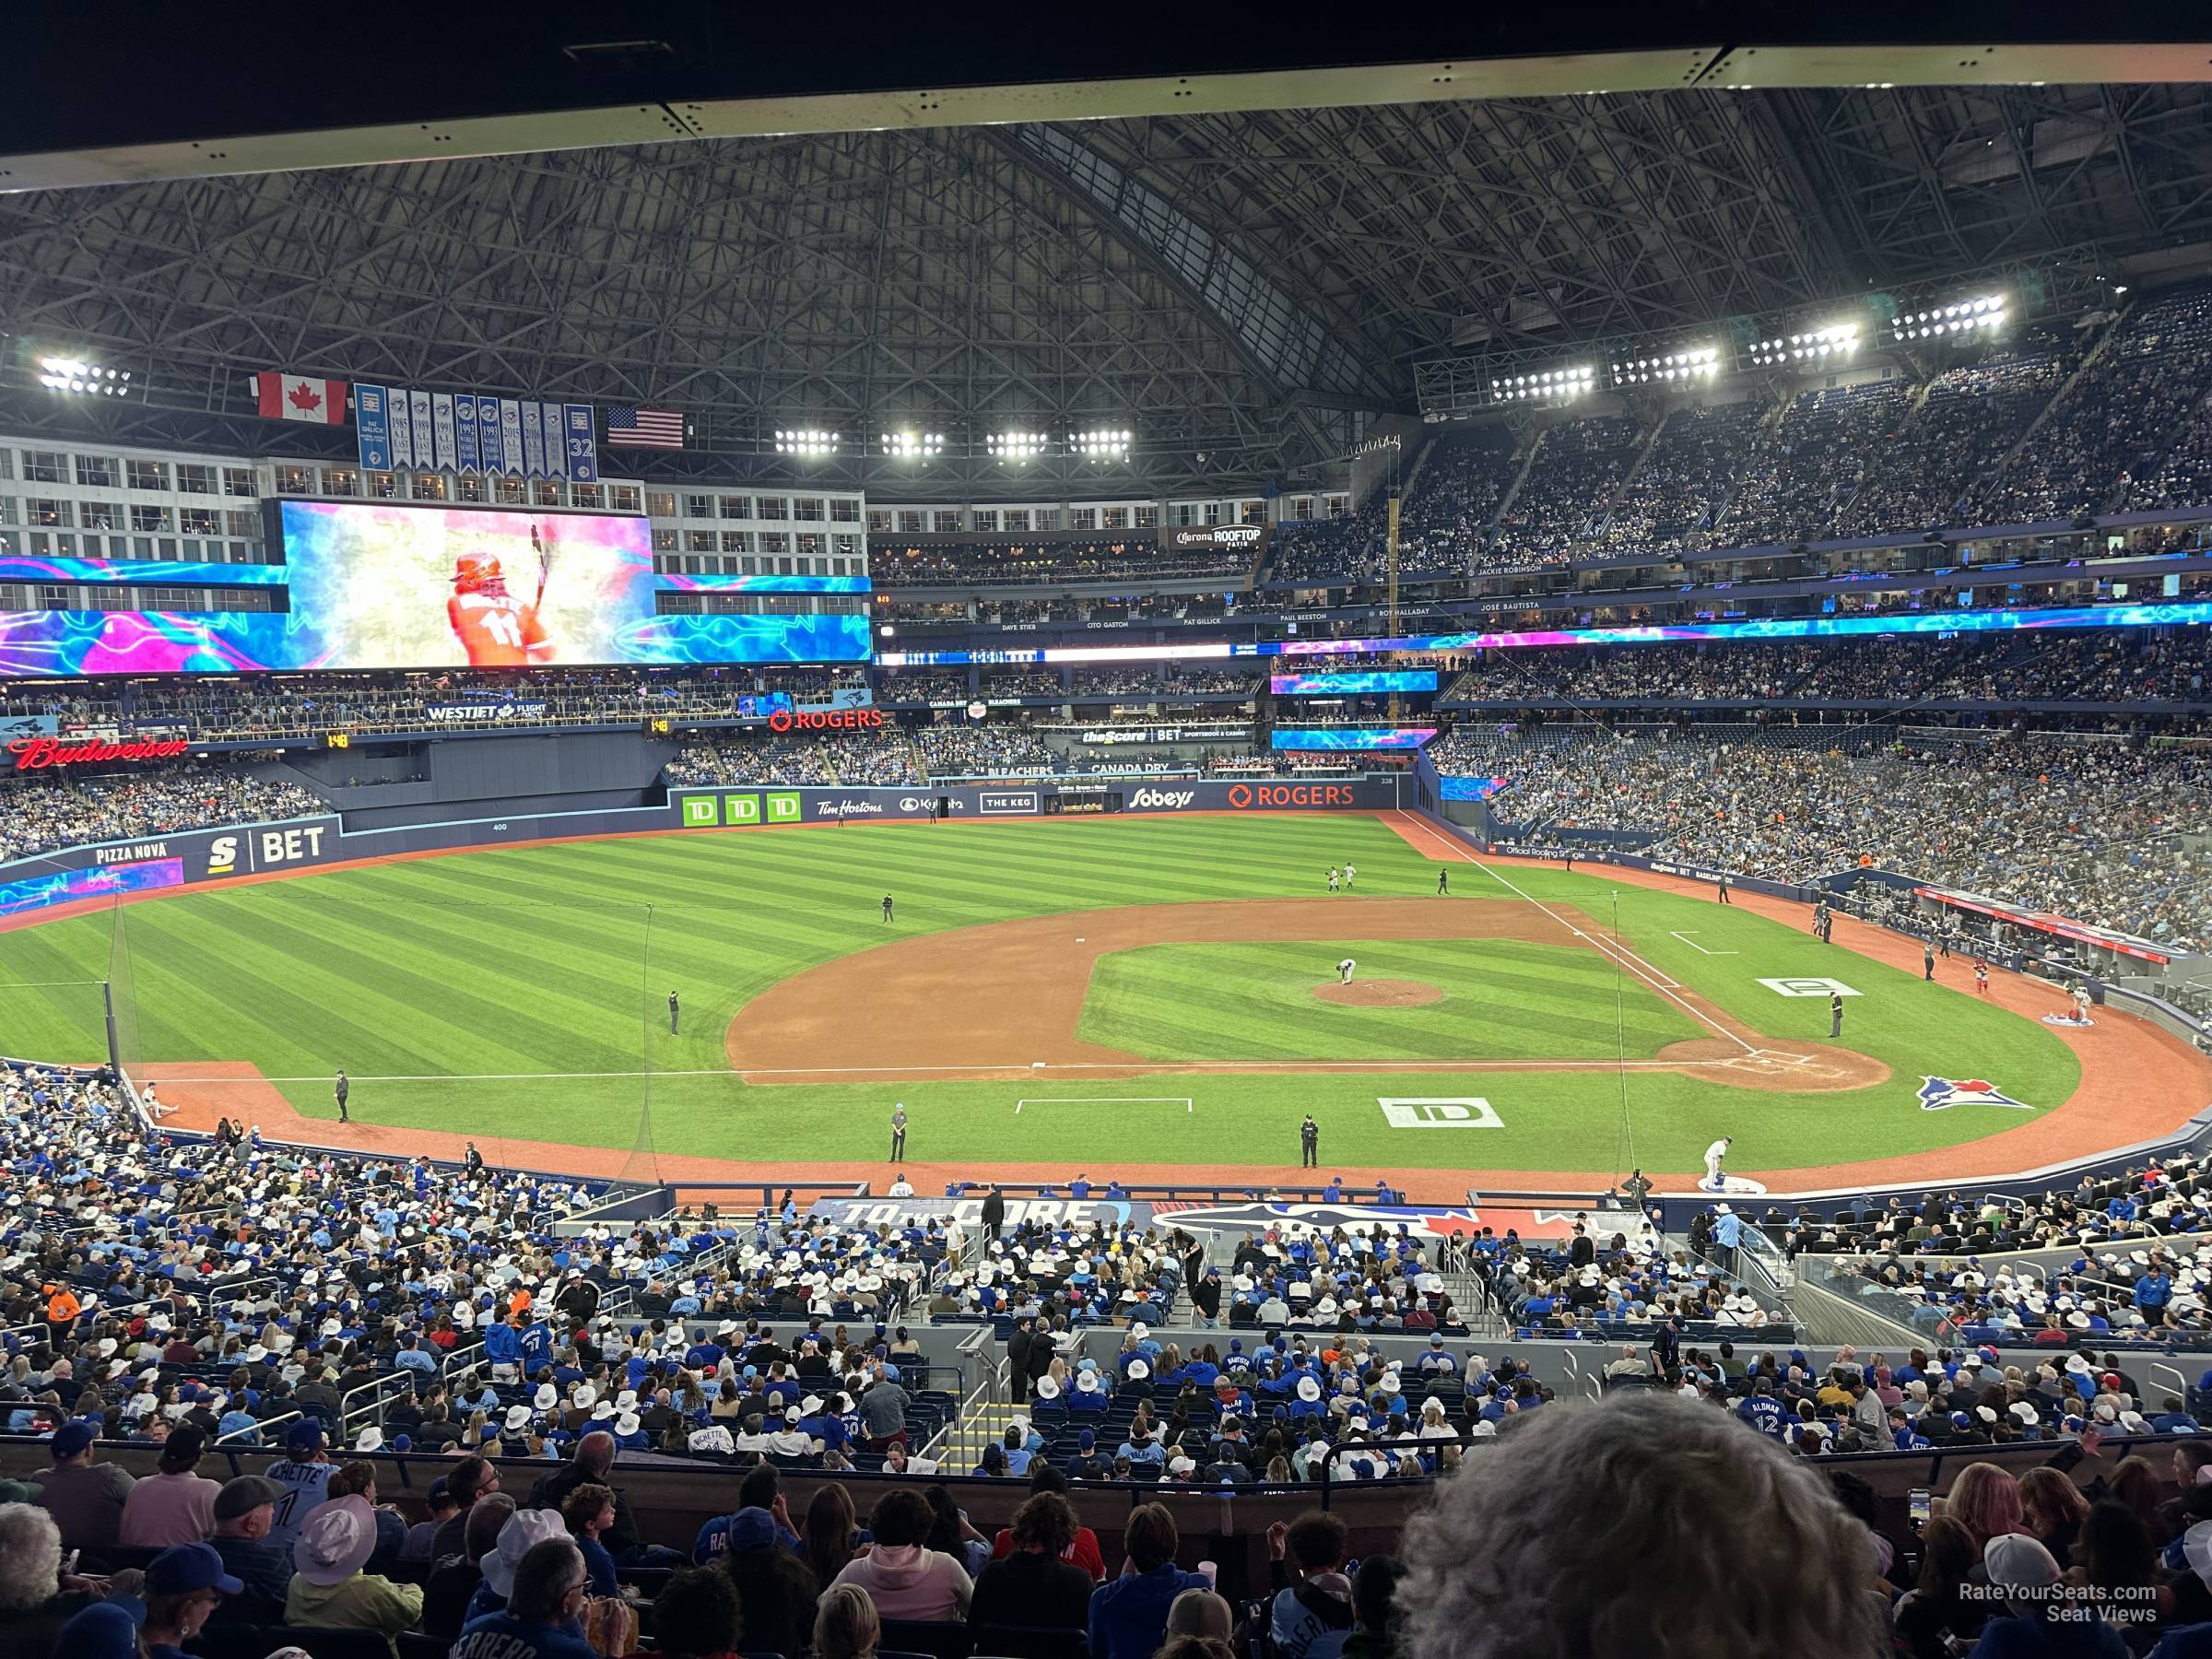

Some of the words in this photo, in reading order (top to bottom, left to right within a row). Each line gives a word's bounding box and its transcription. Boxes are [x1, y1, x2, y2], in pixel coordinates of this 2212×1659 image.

[392, 417, 408, 429] 1985
[414, 419, 430, 432] 1989
[436, 421, 453, 434] 1991
[459, 423, 476, 436] 1992
[483, 425, 500, 438] 1993
[503, 427, 520, 440] 2015
[525, 429, 542, 441] 2016
[394, 439, 409, 449] EAST
[415, 441, 430, 452] EAST
[438, 443, 454, 453] EAST
[569, 438, 594, 457] 32
[1176, 532, 1213, 546] Corona
[1214, 529, 1261, 543] ROOFTOP
[1478, 568, 1502, 576] JACKIE
[1503, 565, 1542, 575] ROBINSON
[1394, 607, 1430, 616] HALLADAY
[1503, 602, 1539, 610] BAUTISTA
[1280, 614, 1296, 622] PAUL
[1297, 613, 1327, 621] BEESTON
[1019, 623, 1036, 631] STIEB
[428, 706, 498, 721] WESTJET
[516, 703, 546, 712] FLIGHT
[797, 710, 884, 729] ROGERS
[1082, 731, 1147, 743] theScore
[1158, 730, 1181, 740] BET
[7, 735, 188, 771] Budweiser
[988, 766, 1054, 776] BLEACHERS
[1090, 764, 1142, 774] CANADA
[1145, 762, 1170, 772] DRY
[1011, 798, 1030, 806] KEG
[1129, 788, 1194, 808] Sobeys
[1258, 786, 1355, 805] ROGERS
[687, 802, 714, 820] TD
[728, 799, 756, 818] TD
[770, 797, 797, 817] TD
[818, 801, 838, 815] Tim
[838, 799, 883, 813] Hortons
[263, 827, 324, 863] BET
[97, 846, 133, 865] PIZZA
[135, 842, 168, 858] NOVA
[1506, 846, 1530, 855] Official
[1532, 849, 1558, 859] Roofing
[1679, 867, 1690, 877] BET
[1393, 1103, 1482, 1122] TD
[841, 1202, 901, 1225] TO
[1227, 1355, 1250, 1366] BAUTISTA
[1222, 1399, 1242, 1410] PILLAR
[1751, 1401, 1780, 1414] ALOMAR
[1754, 1415, 1778, 1432] 12
[693, 1430, 723, 1447] BICHETTE
